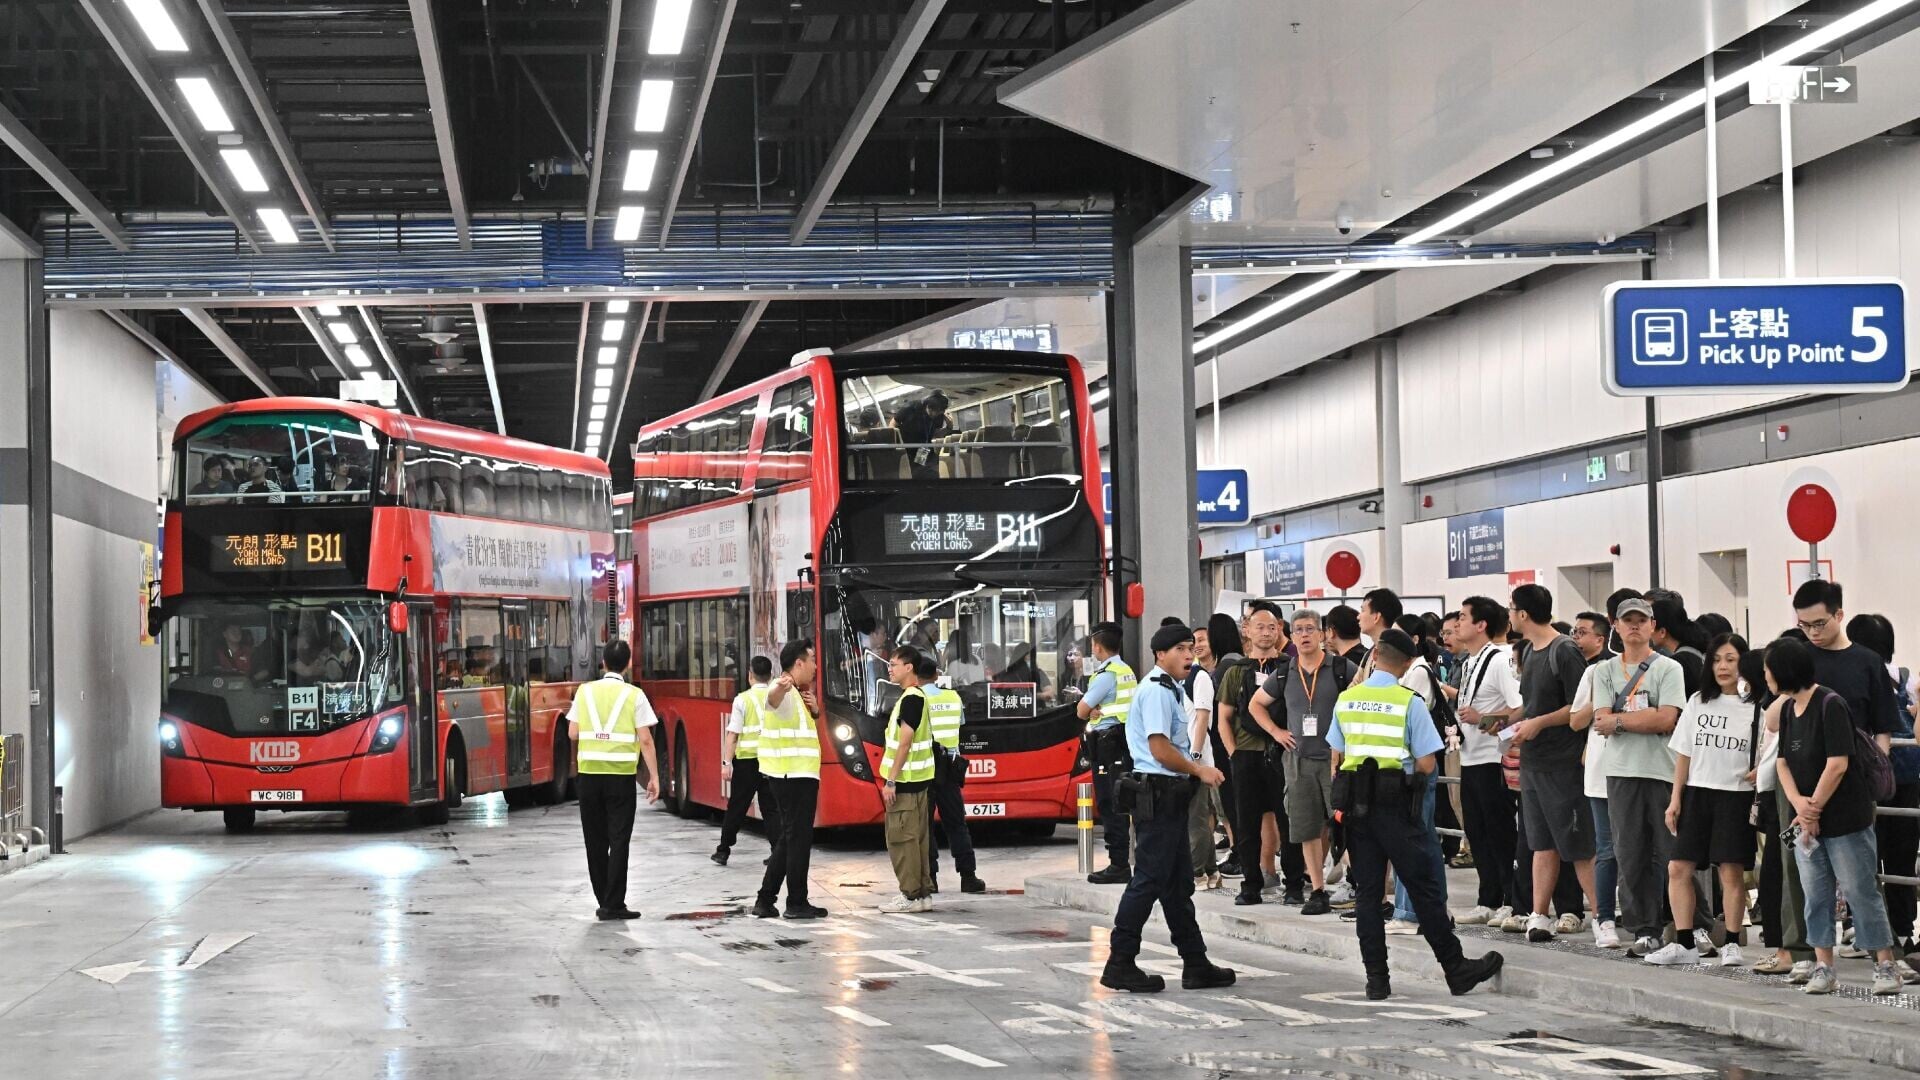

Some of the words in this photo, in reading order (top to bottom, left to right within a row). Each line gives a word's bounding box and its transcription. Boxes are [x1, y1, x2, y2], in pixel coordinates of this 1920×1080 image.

[1700, 307, 1790, 339] 上客點
[1700, 344, 1745, 364] Pick
[1750, 344, 1781, 369] Up
[1787, 343, 1845, 364] Point
[1851, 306, 1888, 363] 5
[1197, 500, 1216, 511] int
[1217, 480, 1241, 511] 4
[901, 514, 940, 532] 元朗
[945, 513, 985, 531] 形點
[225, 535, 259, 550] 元朗
[263, 533, 297, 549] 形點
[915, 531, 940, 541] YOHO
[944, 531, 969, 541] MALL
[1450, 529, 1466, 562] B11
[238, 549, 259, 558] YOHO
[261, 549, 282, 557] MALL
[307, 533, 342, 562] B11
[1263, 559, 1279, 584] NB73
[292, 693, 314, 704] B11
[991, 695, 1032, 709] 演練中
[1356, 701, 1382, 711] POLICE
[292, 711, 315, 730] F4
[1697, 713, 1728, 729] QUI
[1694, 729, 1748, 751] ÉTUDE
[250, 741, 300, 763] KMB
[965, 759, 997, 778] MB
[258, 791, 271, 800] WC
[277, 791, 295, 800] 9181
[972, 804, 1000, 815] 6713
